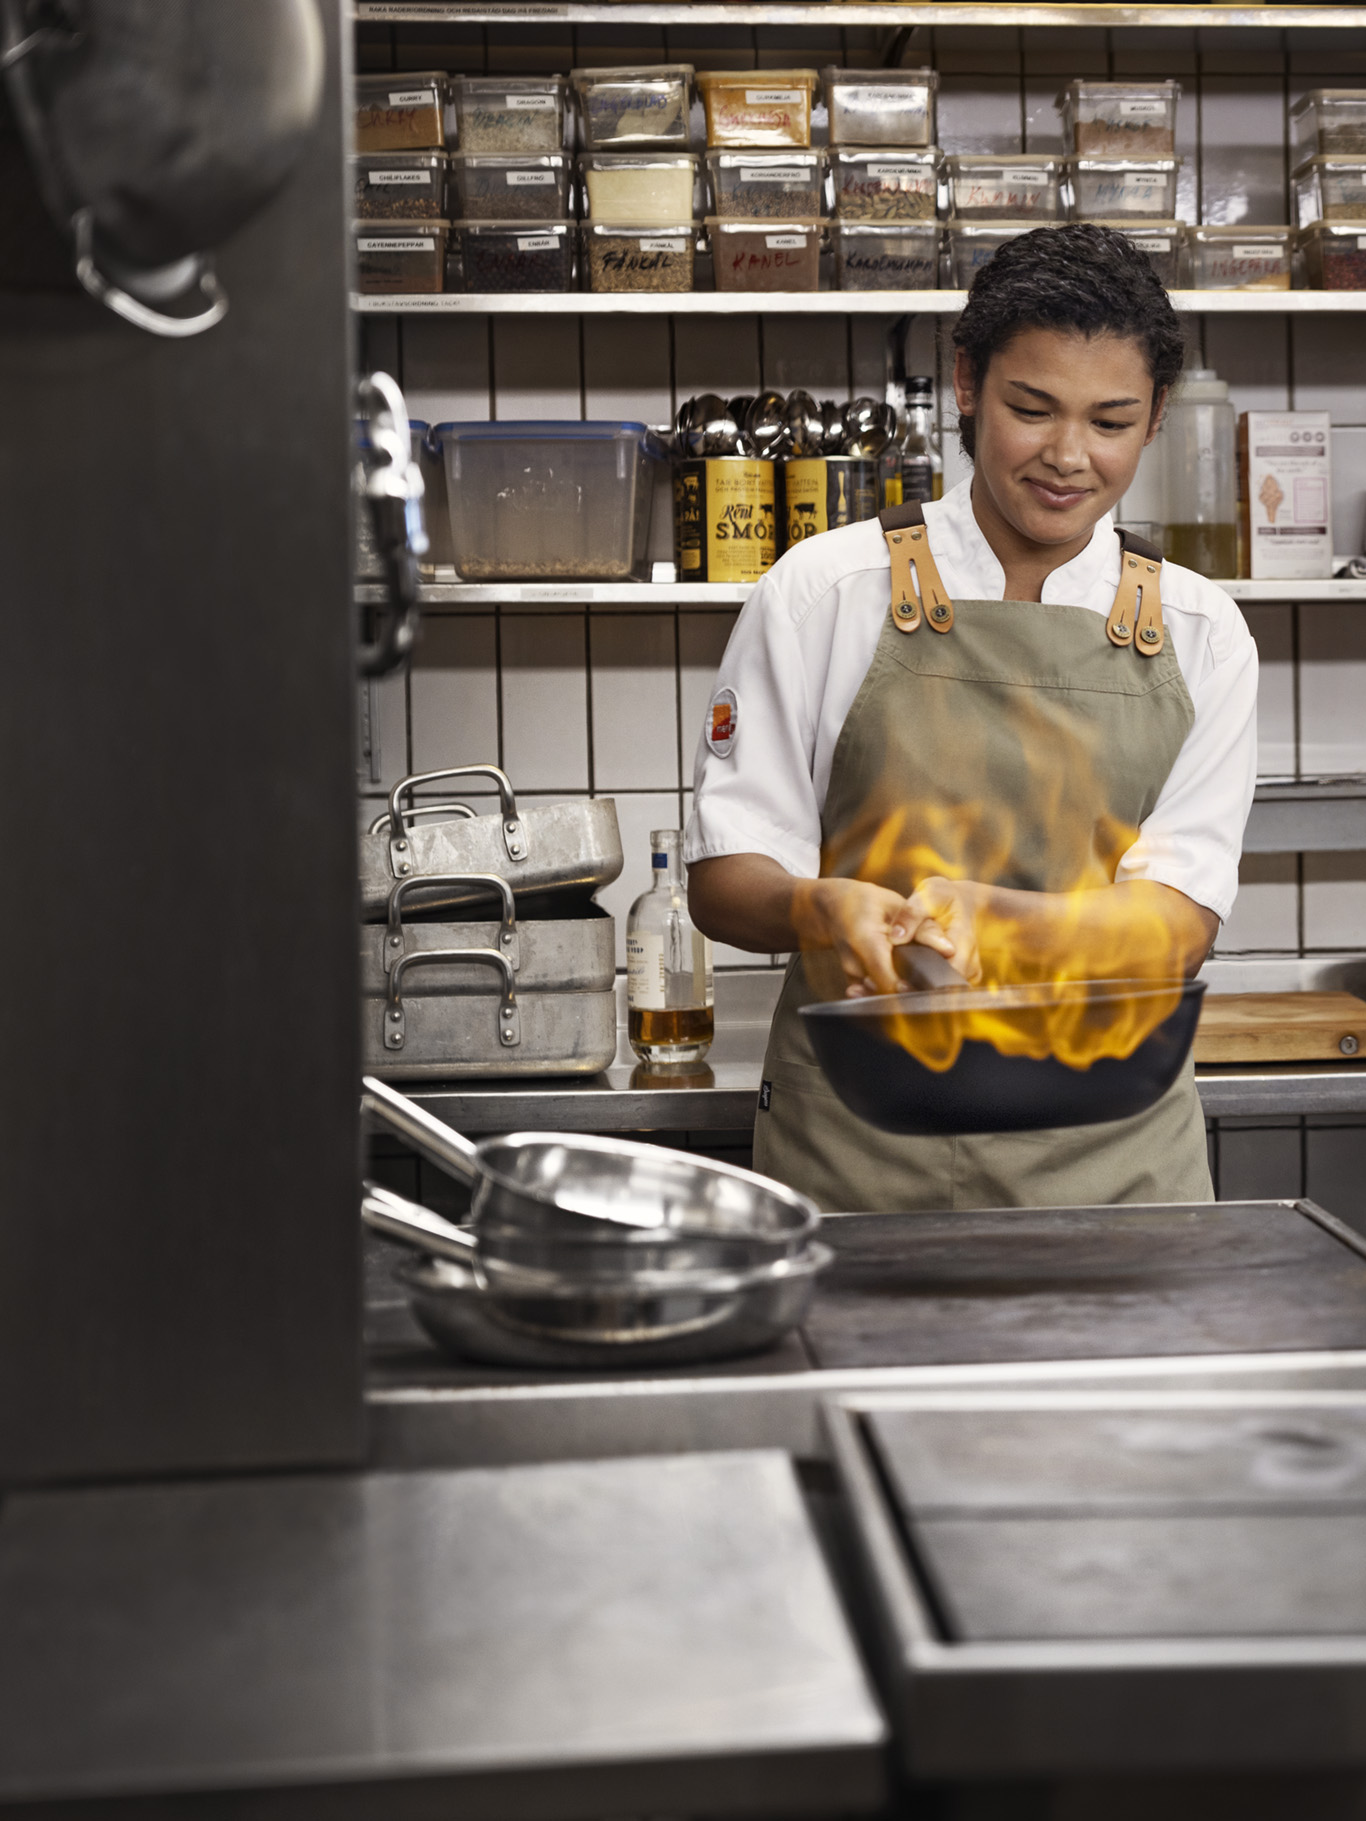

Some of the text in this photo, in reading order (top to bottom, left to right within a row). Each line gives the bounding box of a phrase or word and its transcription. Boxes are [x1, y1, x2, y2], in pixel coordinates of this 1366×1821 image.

[399, 94, 422, 103] CURRY
[516, 98, 546, 106] DRAGON
[379, 174, 421, 182] CHILIFLAKES
[367, 241, 424, 249] CAYENNEPEPPAR
[732, 251, 800, 272] KANEL
[720, 503, 754, 524] Rent
